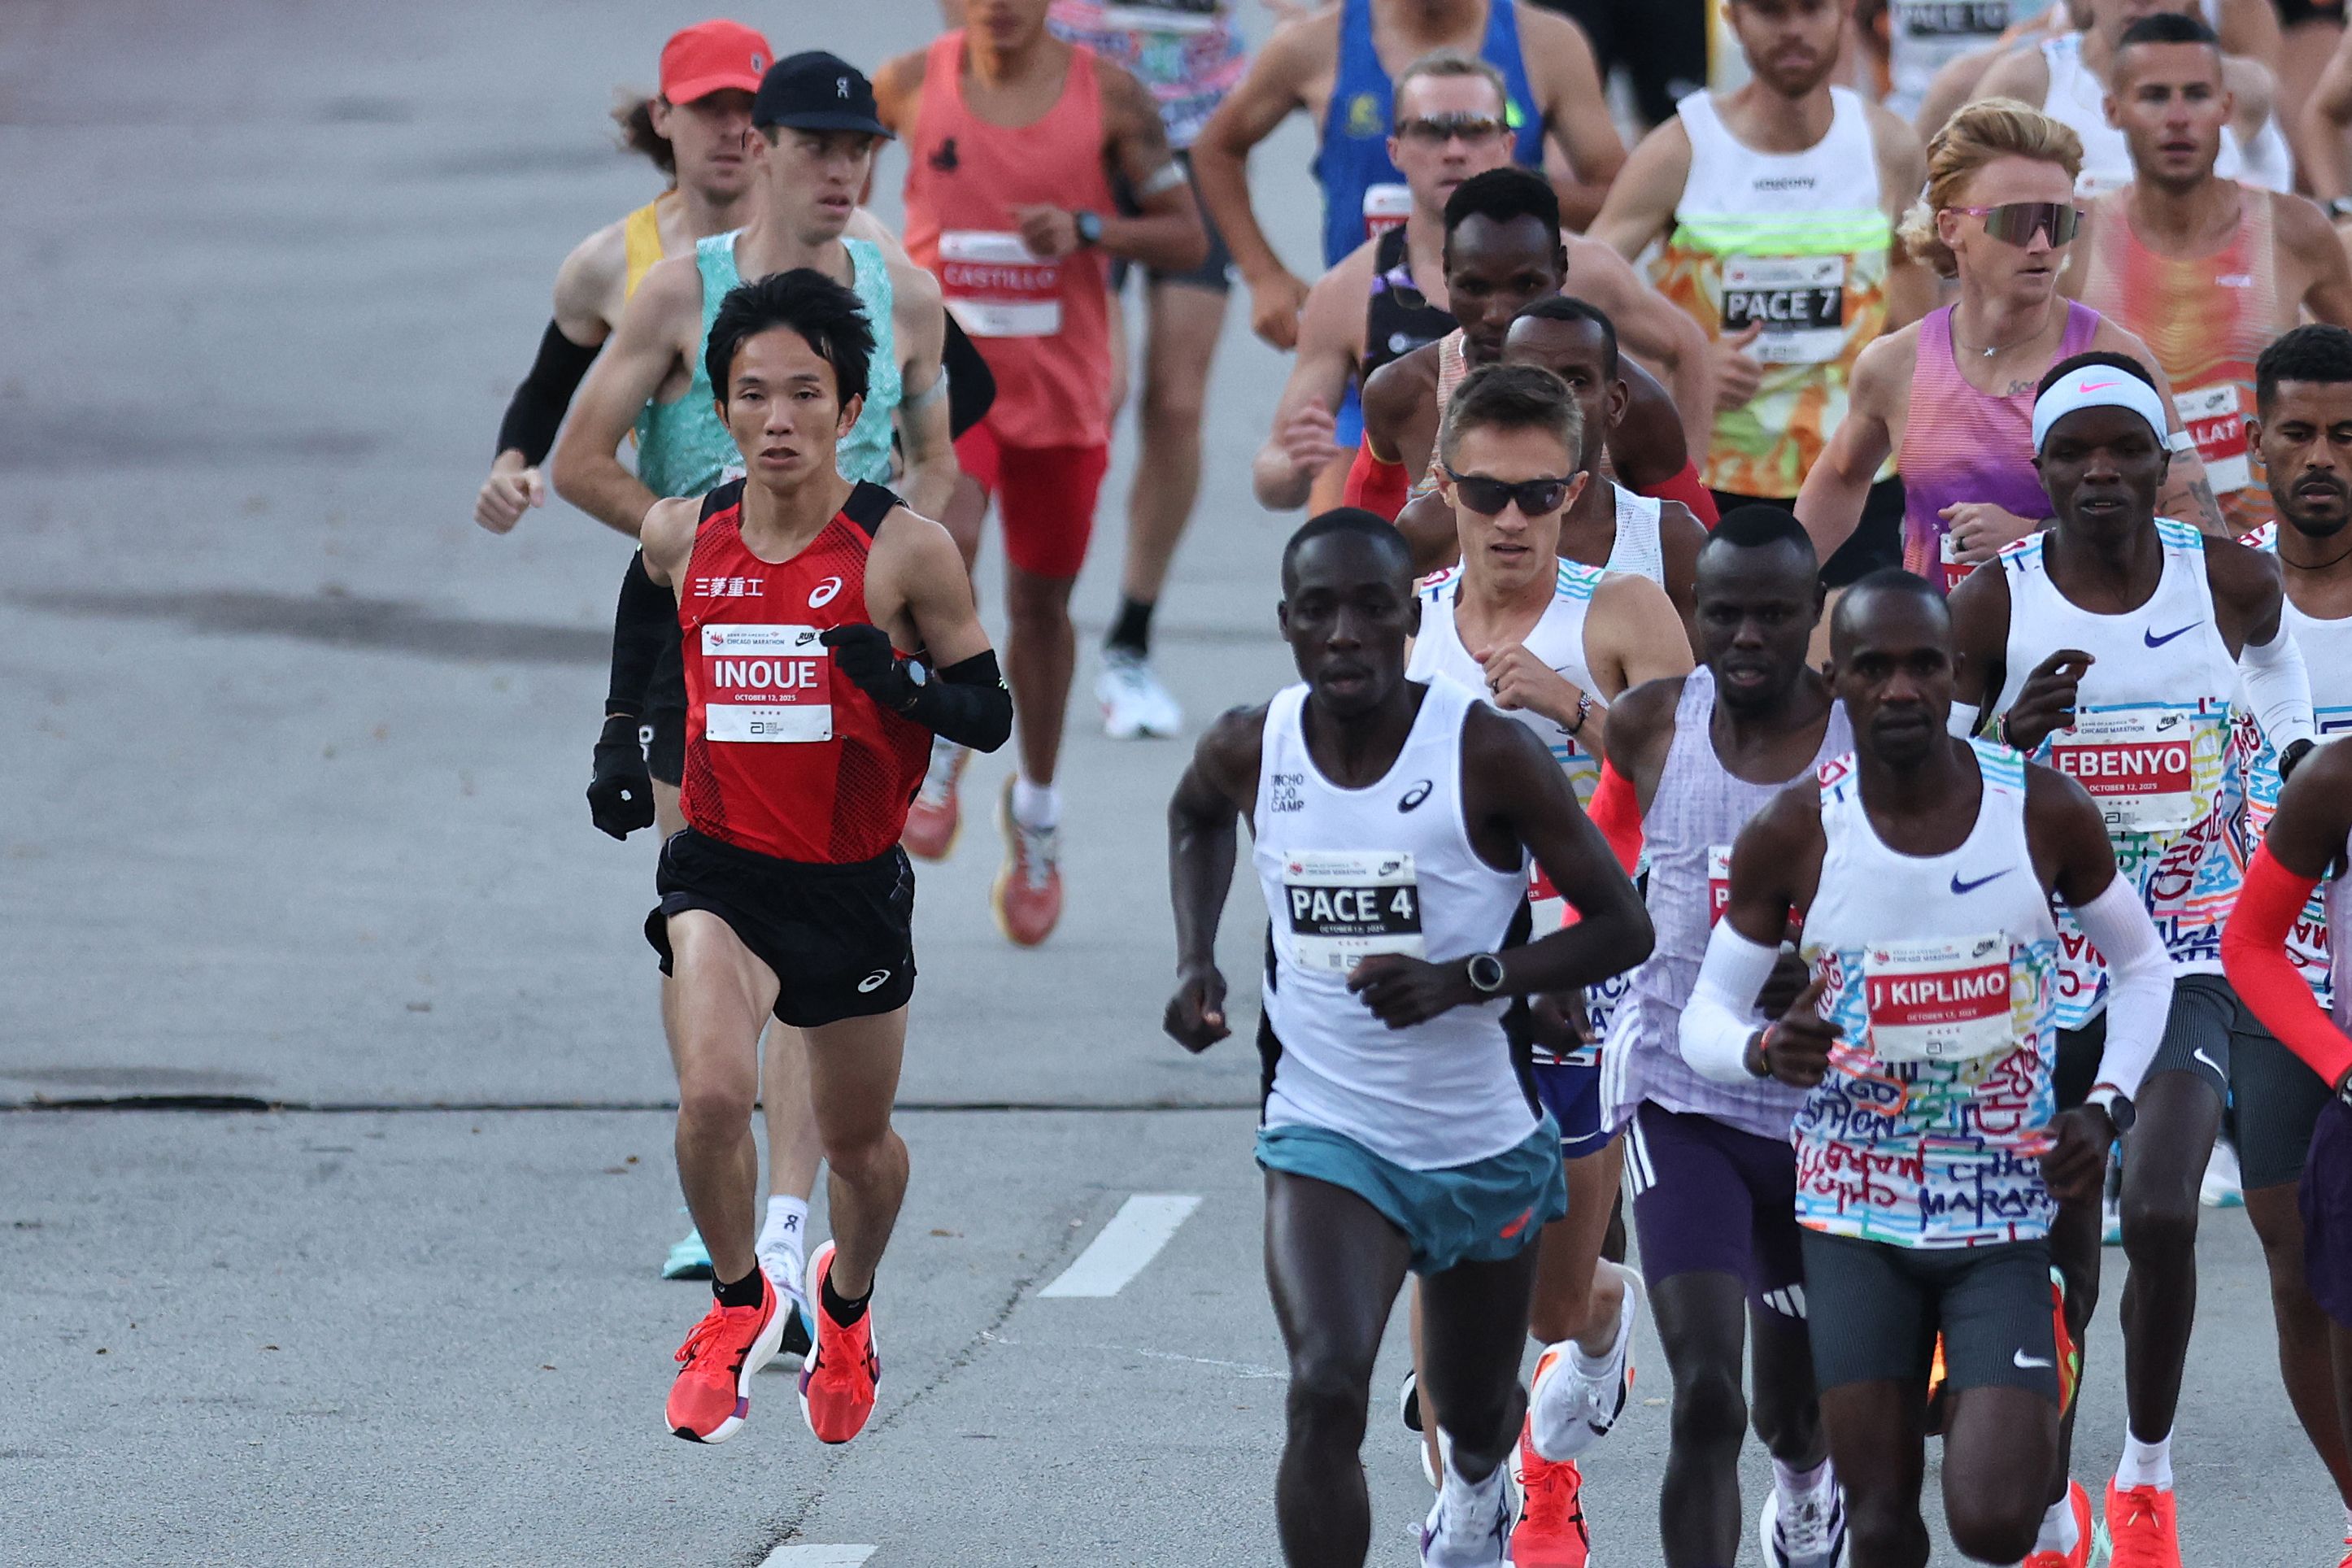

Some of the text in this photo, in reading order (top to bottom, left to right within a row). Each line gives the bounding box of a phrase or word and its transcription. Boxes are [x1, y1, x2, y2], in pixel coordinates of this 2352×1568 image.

[943, 263, 1055, 290] CASTILLO
[1727, 287, 1836, 321] PACE 7
[694, 577, 764, 597] 三菱重工
[715, 660, 818, 689] INOUE
[768, 694, 778, 702] 12,
[2059, 747, 2187, 777] EBENYO
[2088, 784, 2125, 792] OCTOBER
[1270, 799, 1305, 812] CAMP
[1291, 887, 1413, 922] PACE 4
[1871, 983, 1882, 1011] J
[1891, 973, 2006, 1006] KIPLIMO
